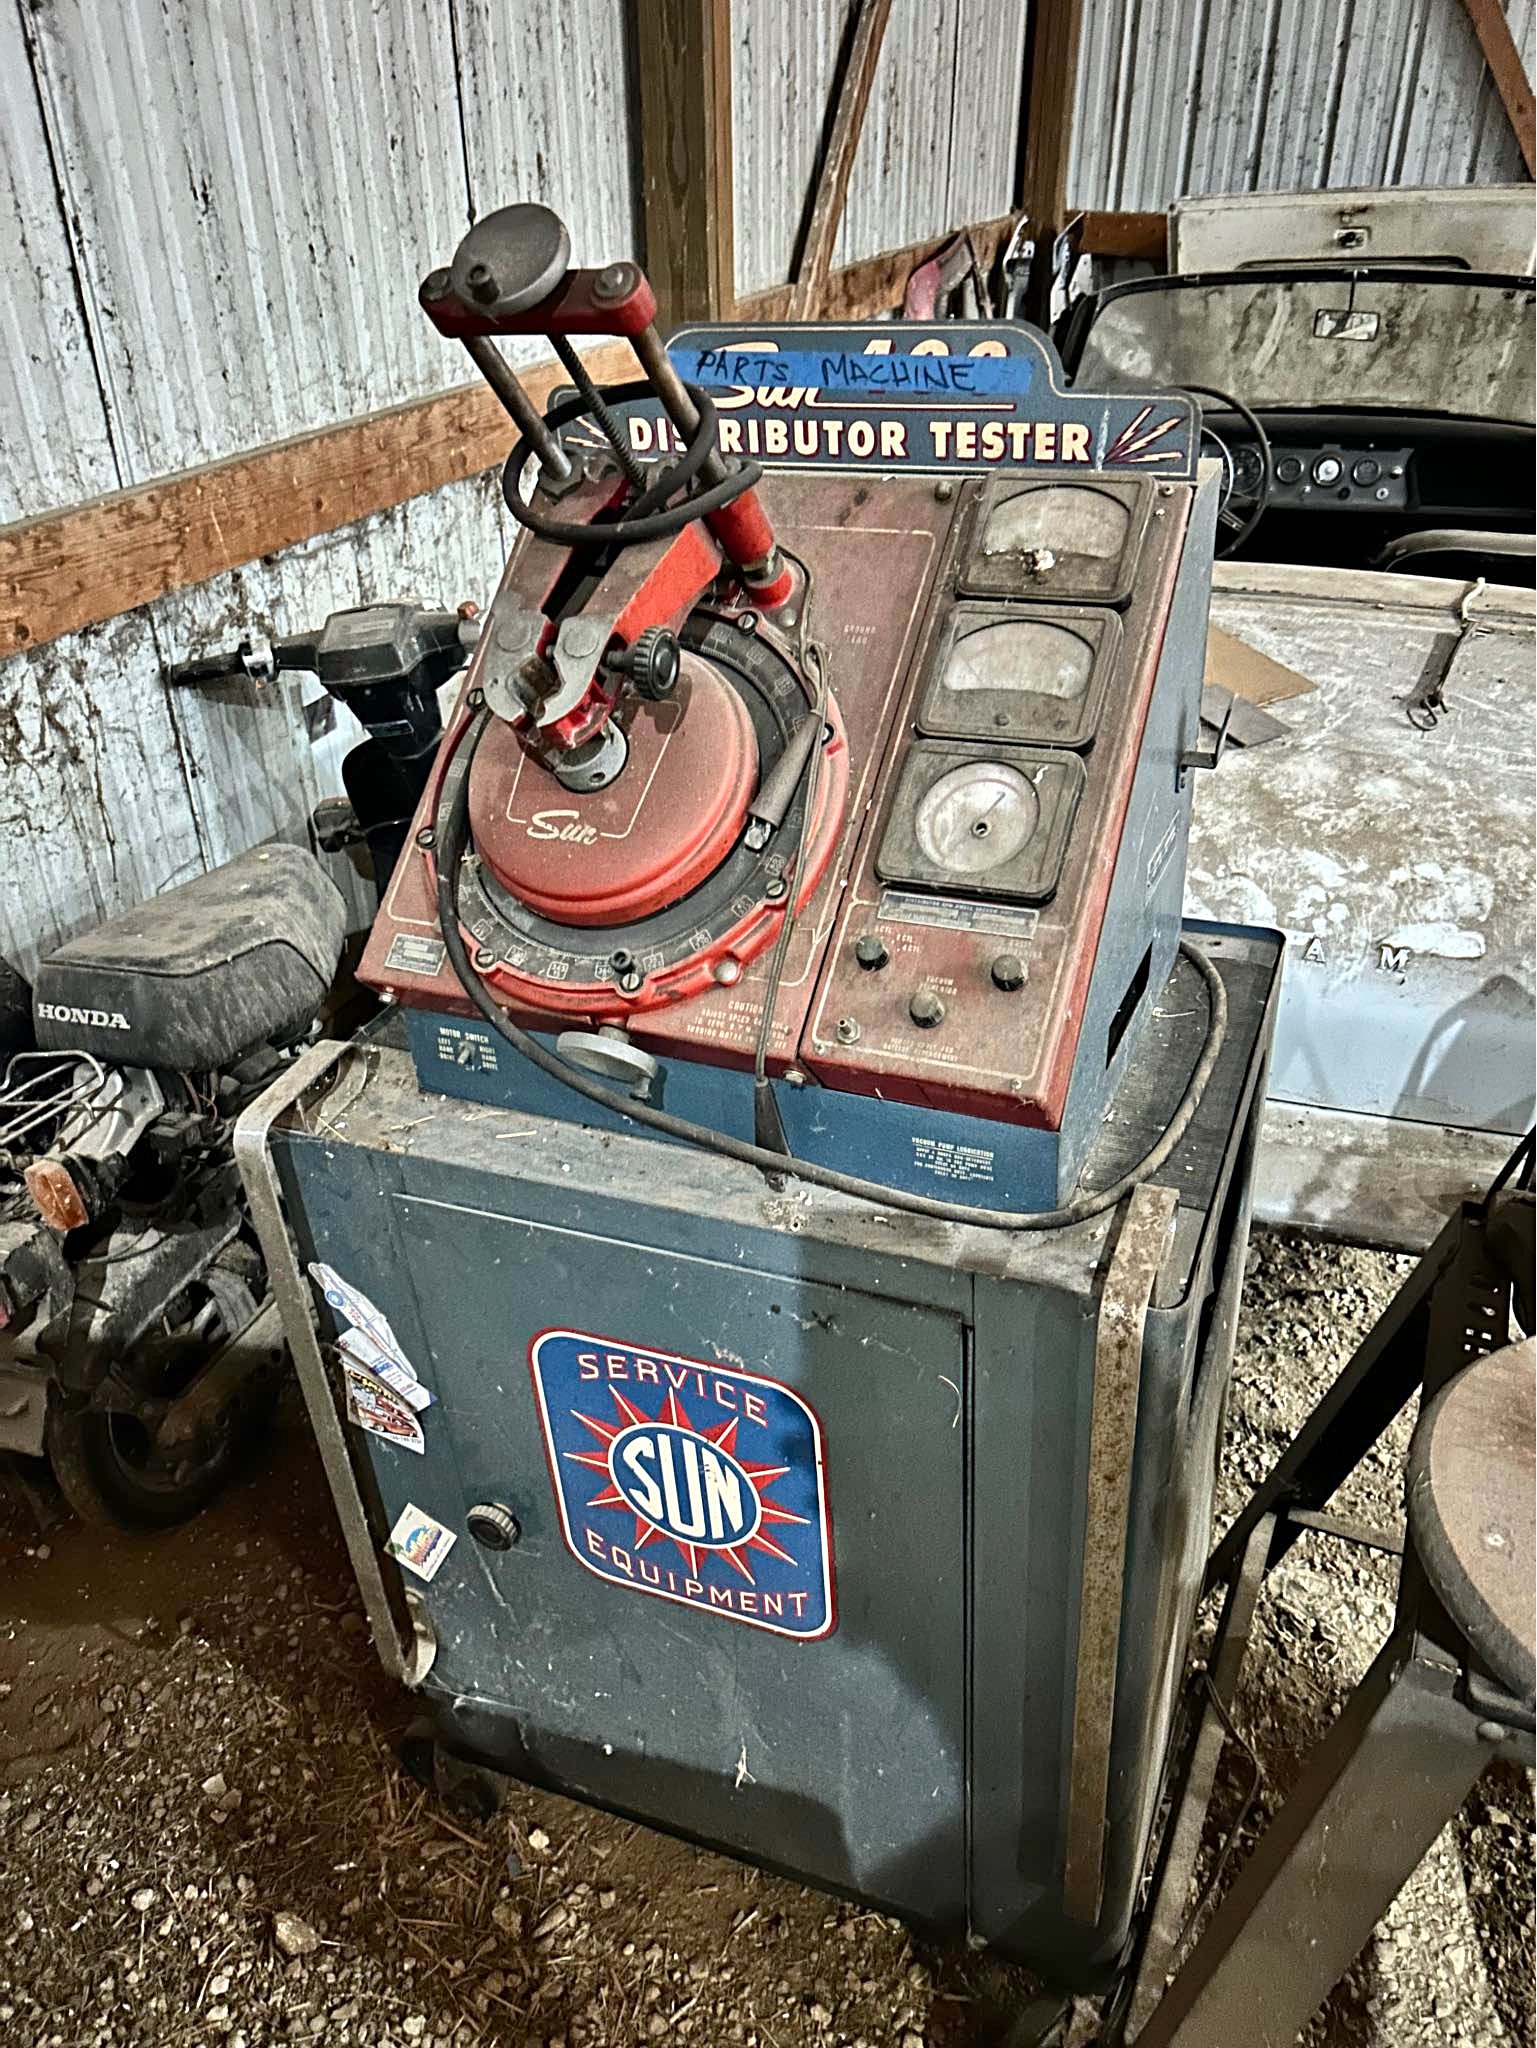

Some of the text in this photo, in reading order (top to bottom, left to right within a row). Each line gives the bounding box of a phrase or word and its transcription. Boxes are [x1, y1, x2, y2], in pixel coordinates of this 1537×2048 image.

[697, 349, 976, 392] PARTS MACHINE
[628, 417, 1091, 461] DIRIBUTOR TESTER
[526, 809, 598, 845] Sun
[37, 1002, 131, 1031] HONDA
[577, 1353, 768, 1427] SERVICE
[622, 1433, 744, 1539] SUN
[586, 1528, 808, 1617] EQUIPMENT
